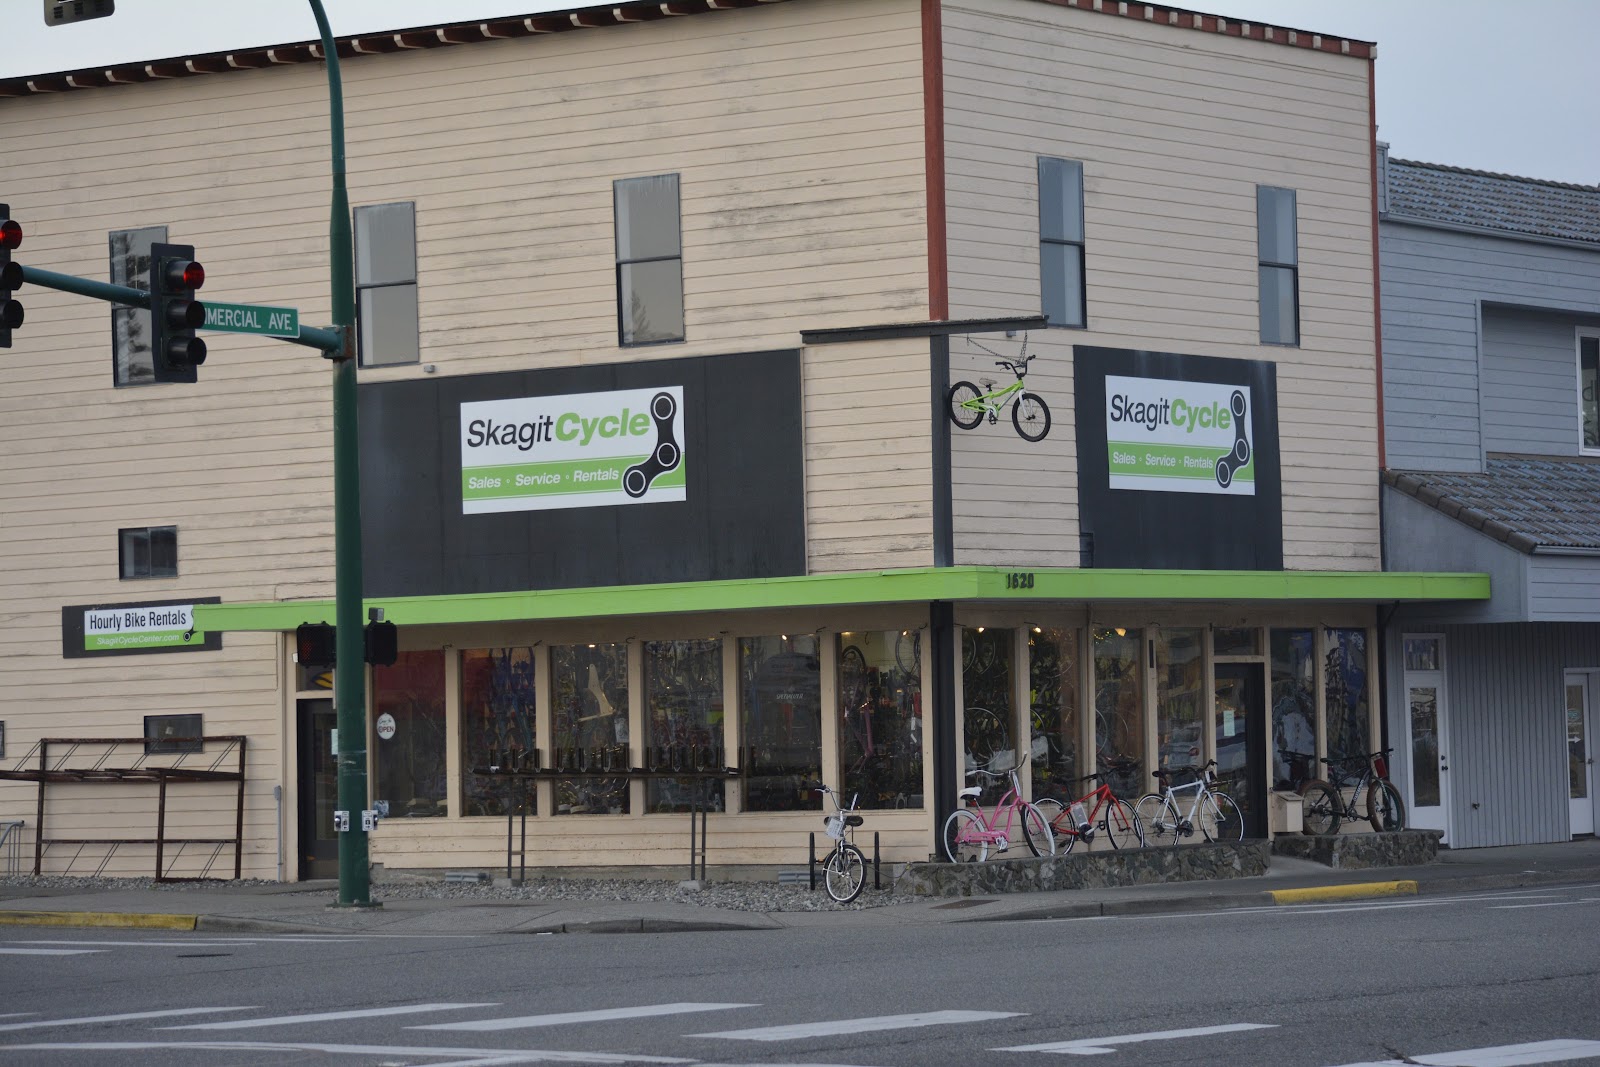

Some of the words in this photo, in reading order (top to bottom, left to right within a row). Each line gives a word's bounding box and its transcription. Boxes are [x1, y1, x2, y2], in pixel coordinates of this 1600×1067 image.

[1112, 452, 1136, 465] Sales
[1145, 453, 1176, 467] Service
[1183, 456, 1214, 469] Rentals
[468, 476, 501, 490] Sales
[515, 471, 561, 487] Service
[573, 468, 620, 483] Rentals
[1006, 572, 1034, 589] 1620
[90, 613, 122, 631] Hourly
[125, 612, 146, 628] Bike
[149, 610, 187, 627] Rentals
[96, 634, 180, 646] SkagitCycleCenter.com
